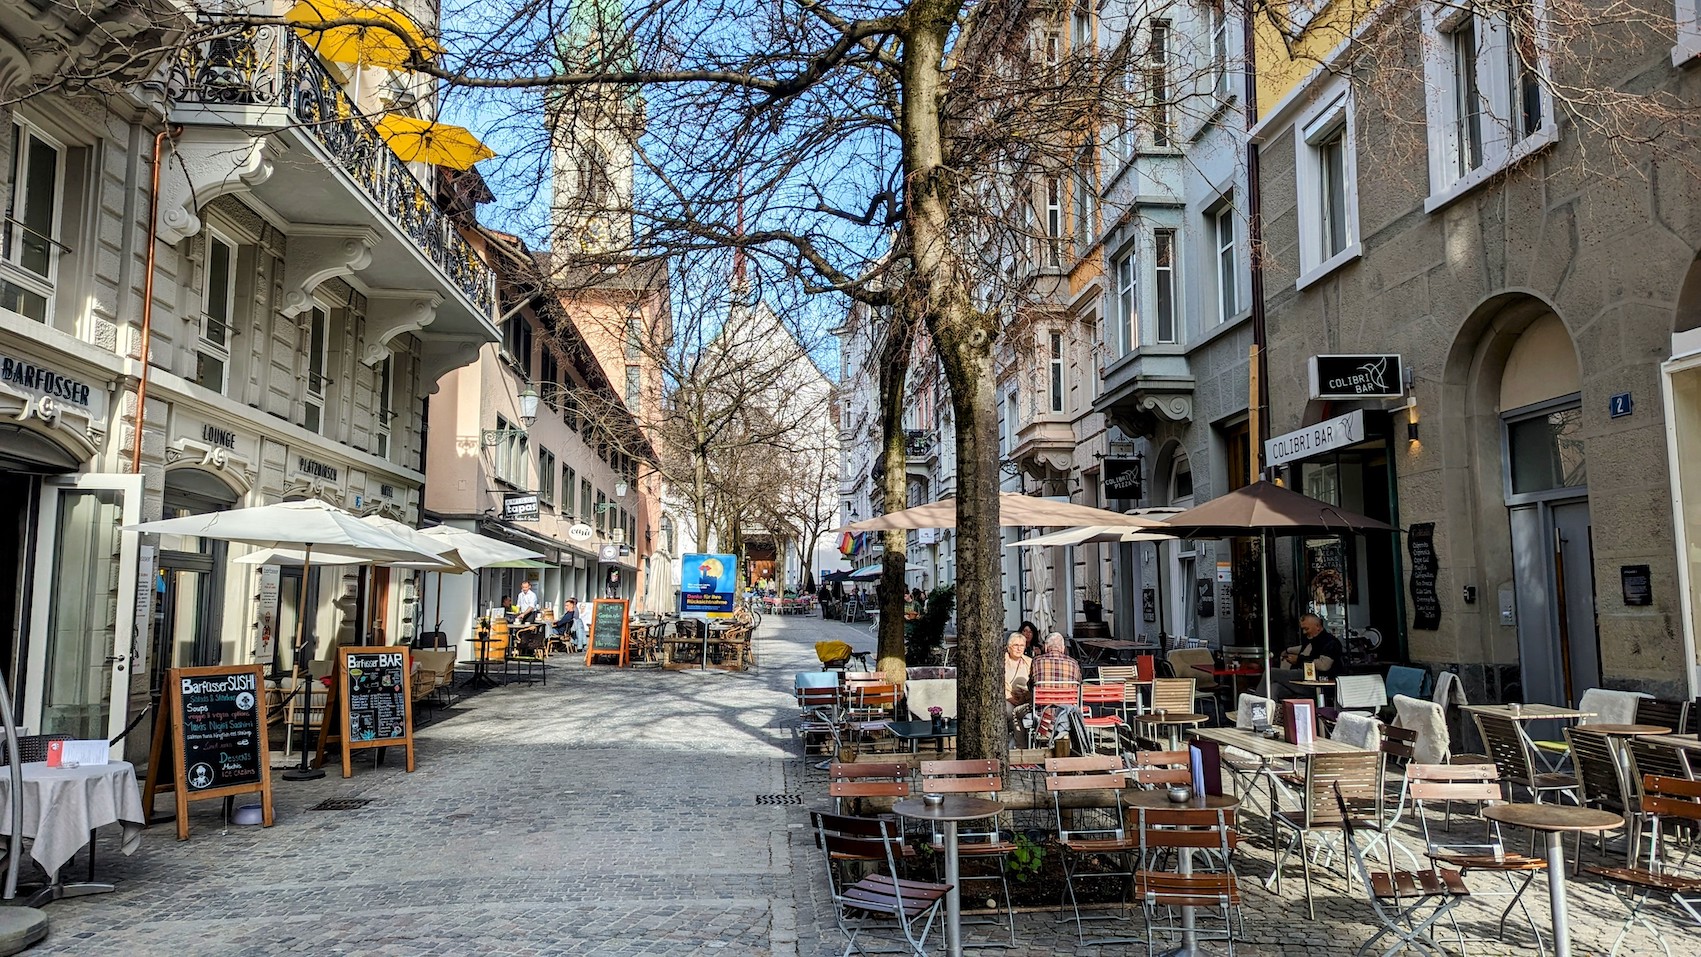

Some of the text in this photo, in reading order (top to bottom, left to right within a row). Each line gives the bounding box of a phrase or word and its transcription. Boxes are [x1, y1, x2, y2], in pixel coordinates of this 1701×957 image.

[1329, 373, 1370, 389] COLIBRI
[1355, 383, 1374, 394] BAR
[1616, 397, 1624, 413] 2
[203, 424, 236, 450] LOUNGE
[1272, 426, 1334, 459] COLIBRI BAR
[1105, 475, 1129, 486] COLIBRI
[1114, 481, 1132, 490] PIZZA
[506, 503, 537, 514] tapas
[379, 653, 402, 667] BAR
[227, 674, 255, 691] SUSHI
[186, 703, 208, 714] Soups
